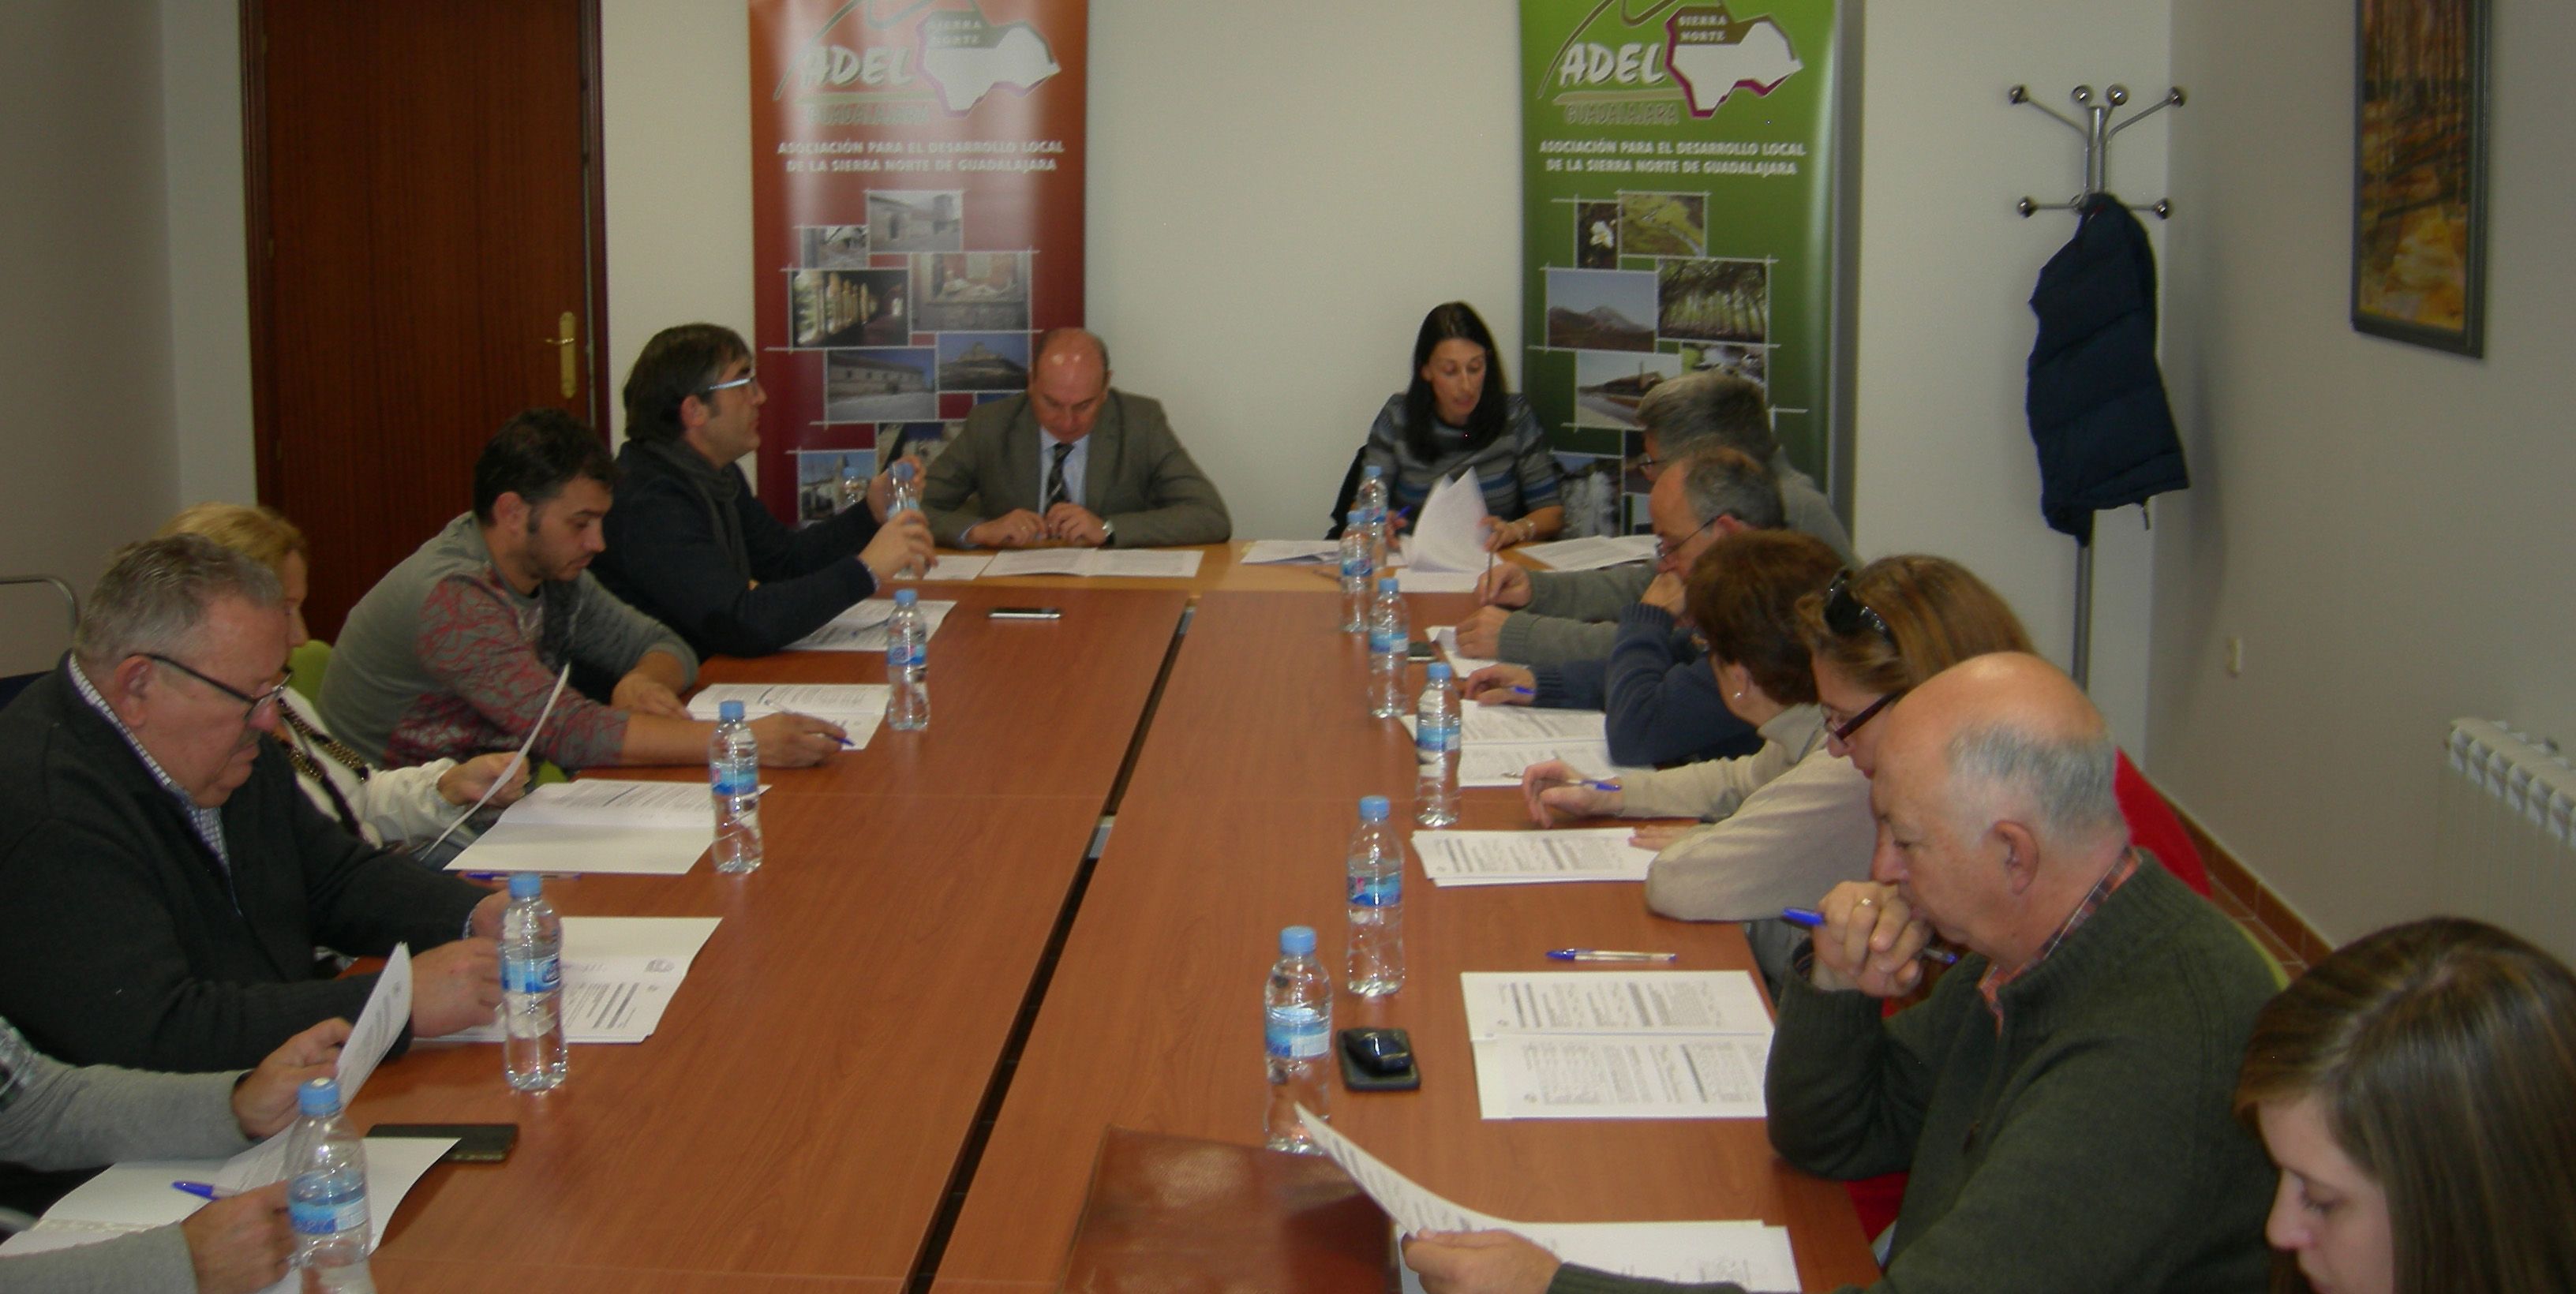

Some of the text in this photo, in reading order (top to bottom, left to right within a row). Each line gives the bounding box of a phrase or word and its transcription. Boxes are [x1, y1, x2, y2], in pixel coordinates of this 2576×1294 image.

[1678, 15, 1727, 26] SIERRA
[1680, 31, 1726, 42] NORTE
[799, 43, 918, 88] ADEL
[1559, 43, 1667, 88] ADEL
[777, 138, 1065, 155] ASOCIACIÓN PARA EL DESARROLLO LOCAL
[1539, 137, 1807, 156] ASOCIACIÓN PARA EL DESARROLLO LOCAL
[786, 159, 1058, 174] DE LA SIERRA NORTE DE GUADALAJARA
[1545, 159, 1798, 178] DE LA SIERRA NORTE DE GUADALAJARA
